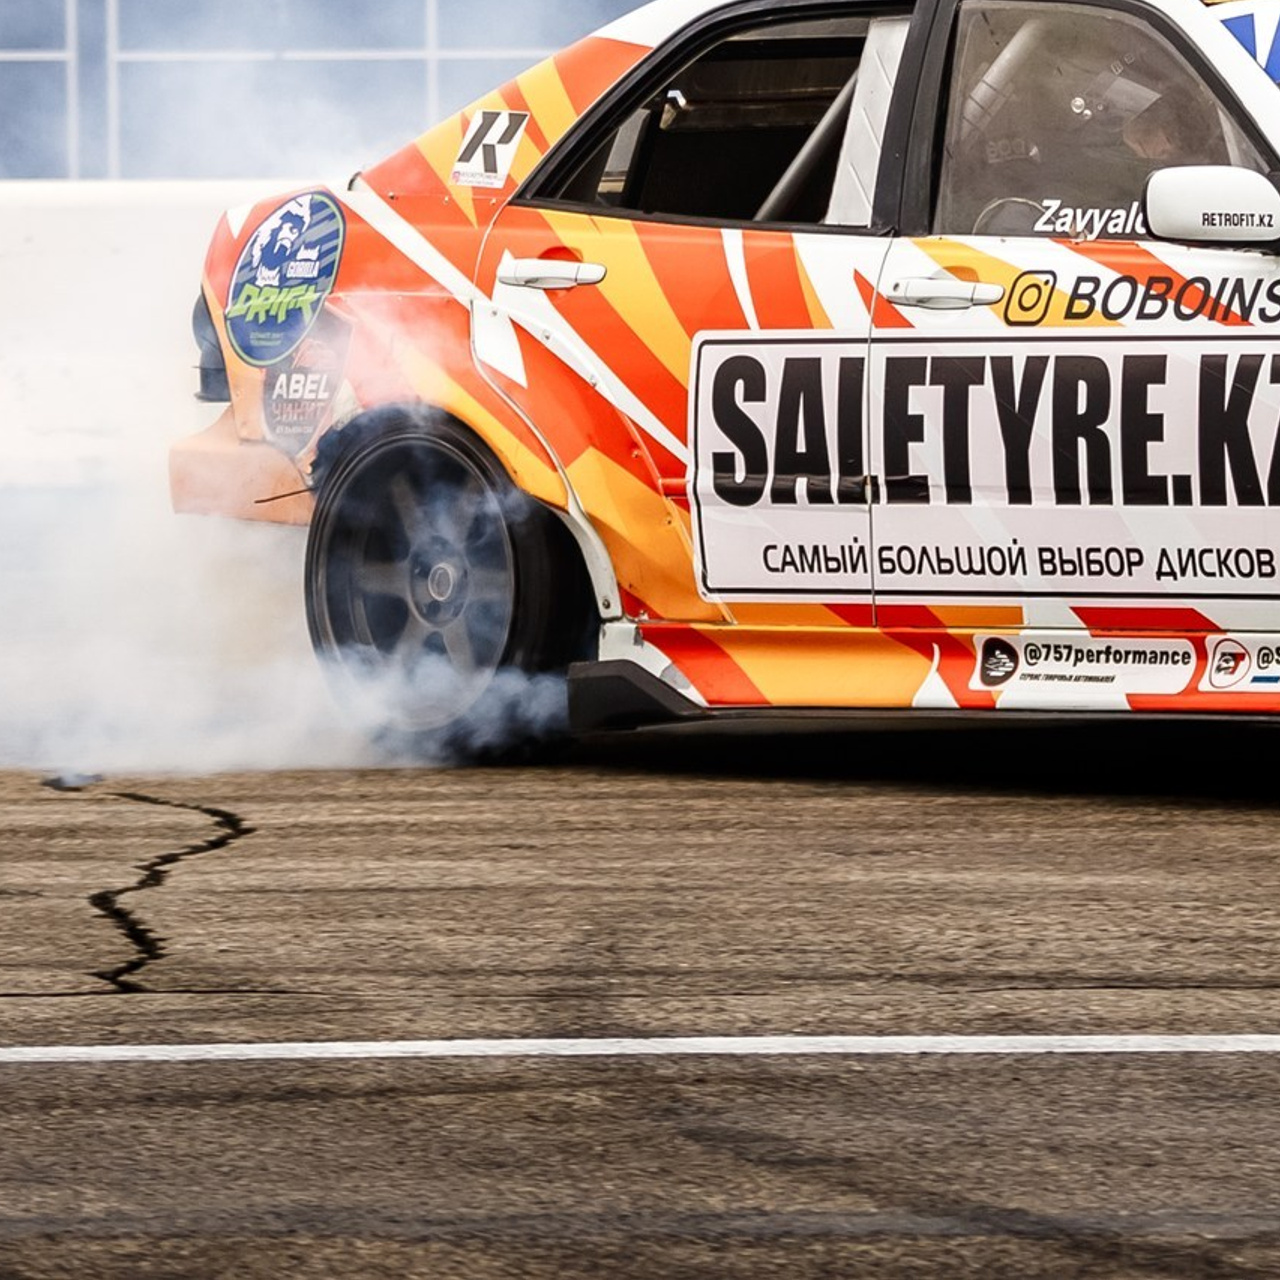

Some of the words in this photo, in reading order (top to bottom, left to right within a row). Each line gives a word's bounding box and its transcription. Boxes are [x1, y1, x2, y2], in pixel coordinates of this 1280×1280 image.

[1201, 212, 1275, 228] RETROFIT.KZ
[272, 373, 330, 400] ABEL
[762, 536, 868, 575] САМЫЙ
[878, 537, 1029, 578] БОЛЬШОЙ
[1037, 546, 1145, 578] ВЫБОР
[1155, 546, 1277, 581] ДИСКОВ
[1024, 643, 1191, 666] @757performance
